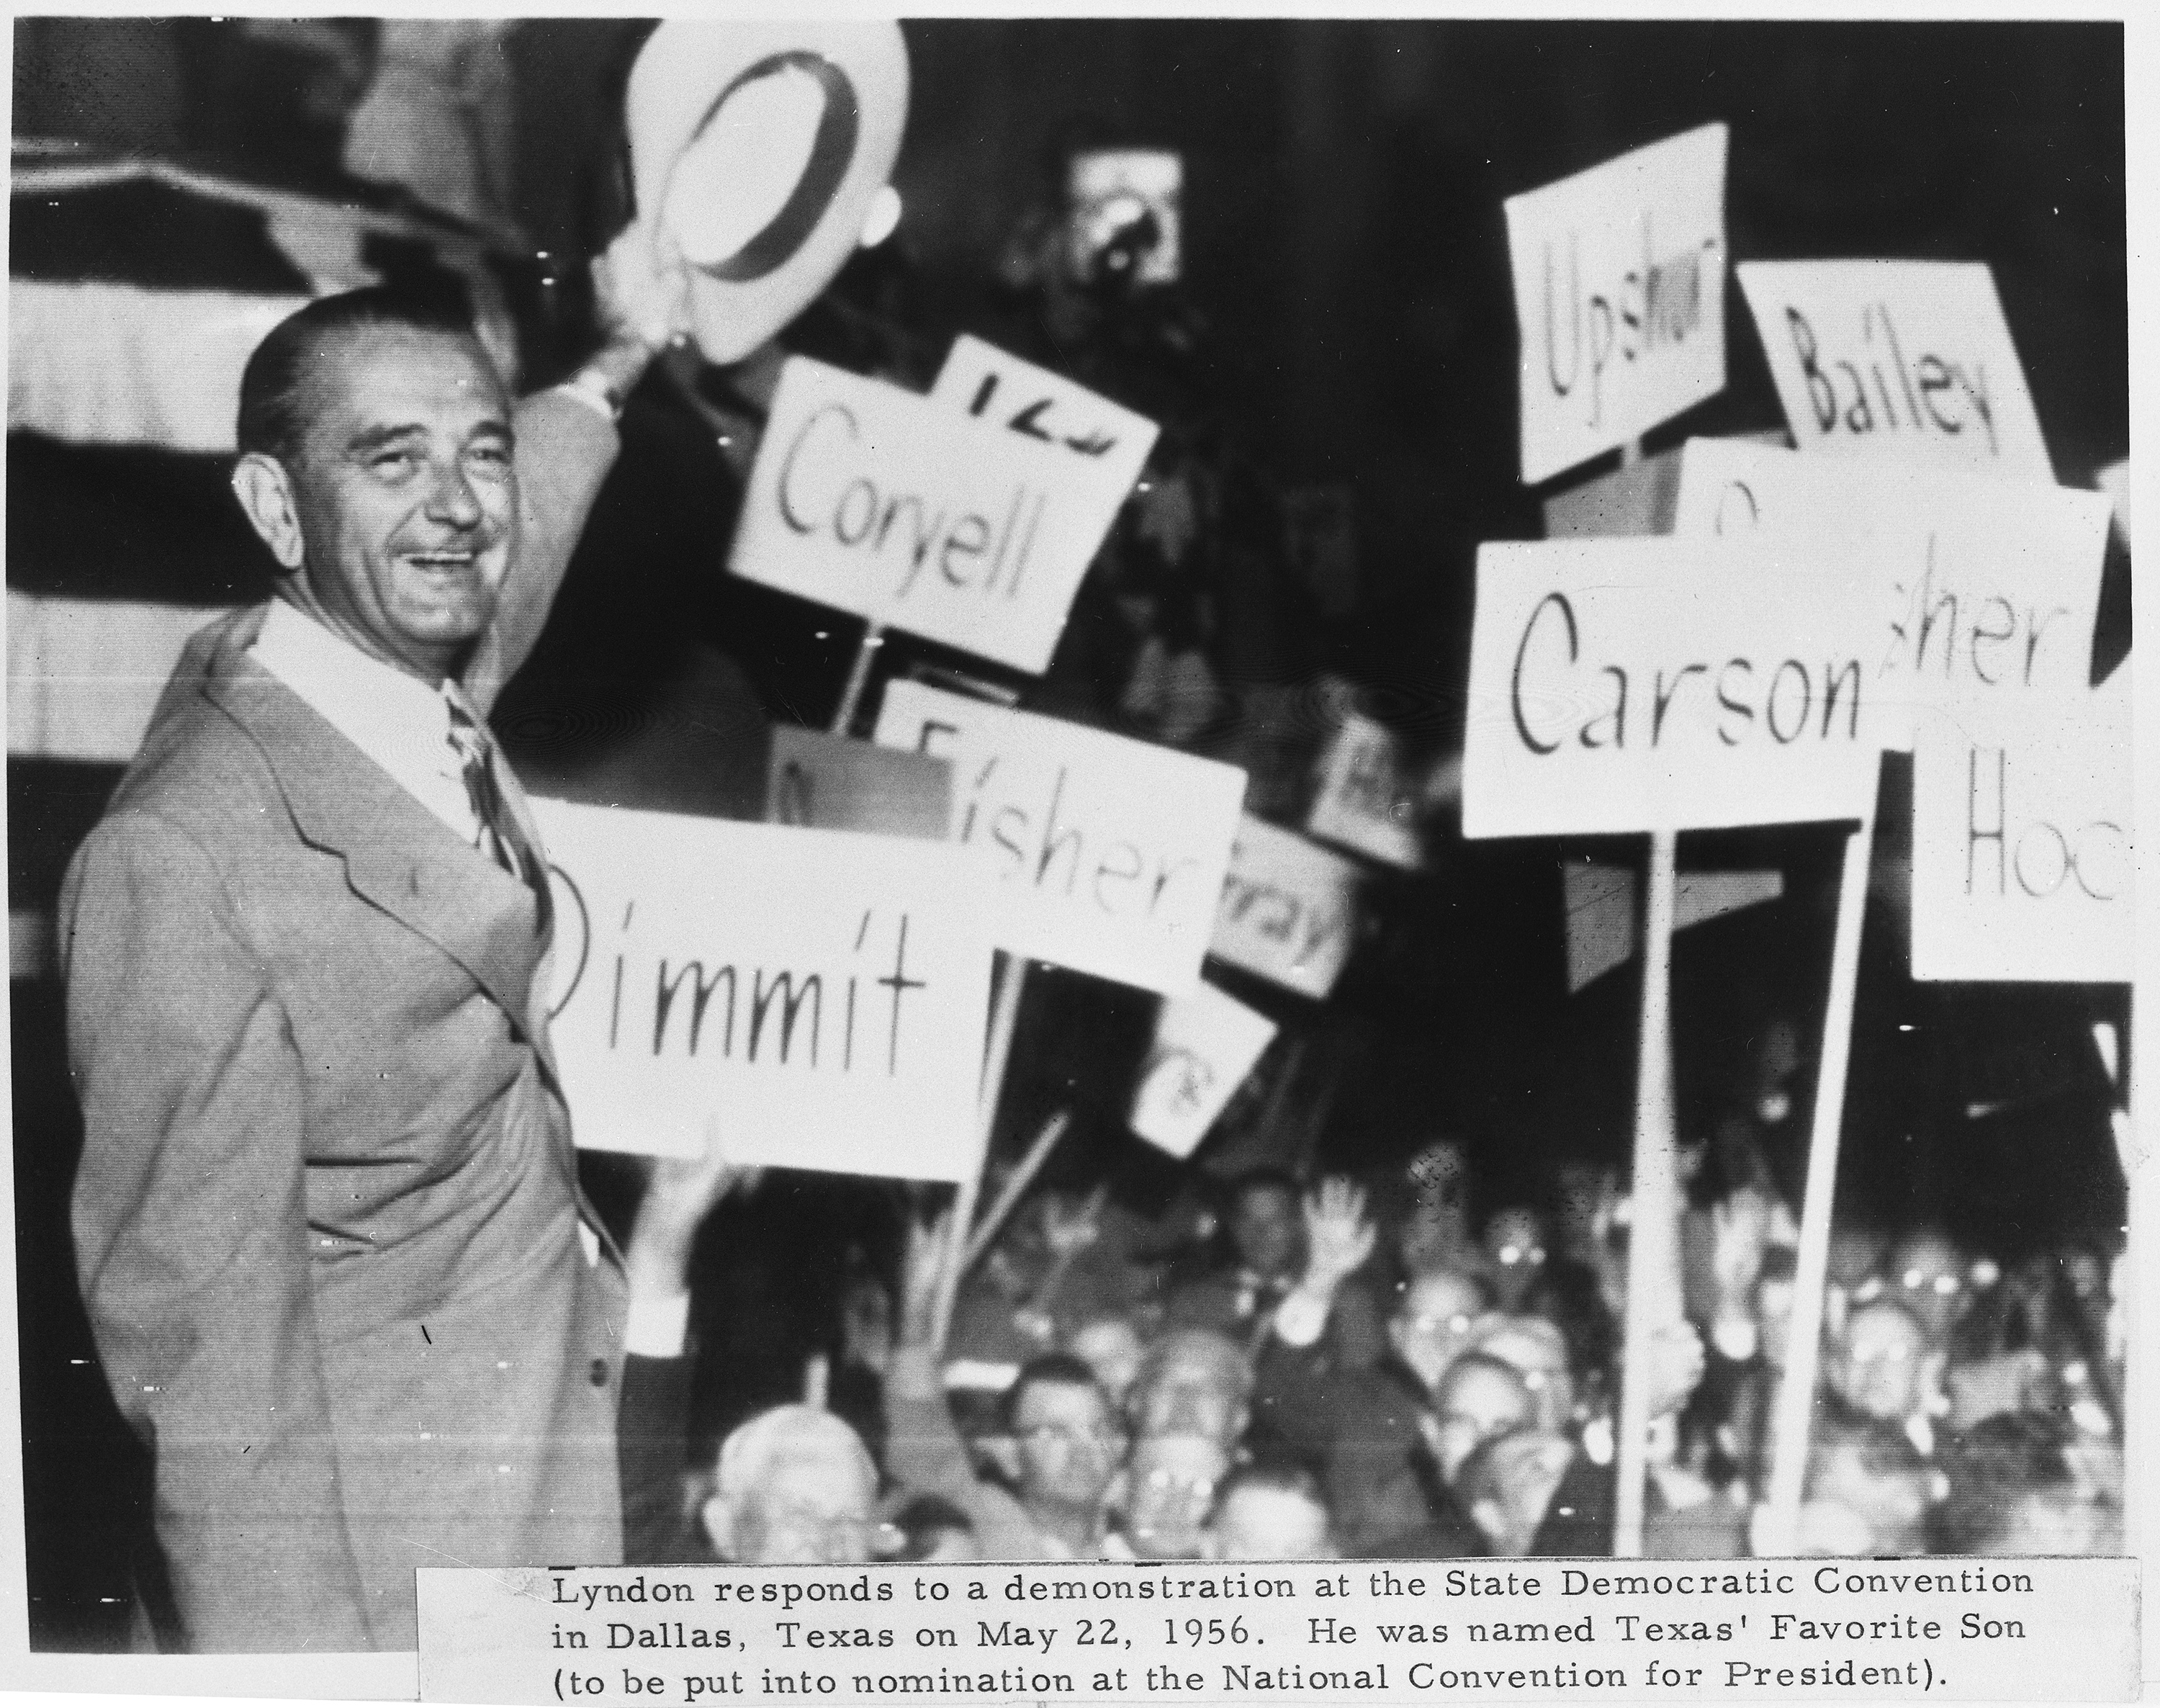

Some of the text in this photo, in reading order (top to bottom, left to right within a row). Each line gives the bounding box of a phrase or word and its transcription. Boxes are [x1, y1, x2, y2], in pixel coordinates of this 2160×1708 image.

[1785, 300, 2000, 457] Bailey
[776, 400, 1047, 598] Coryell
[1511, 592, 1862, 756] Carson
[1222, 838, 1341, 966] ray
